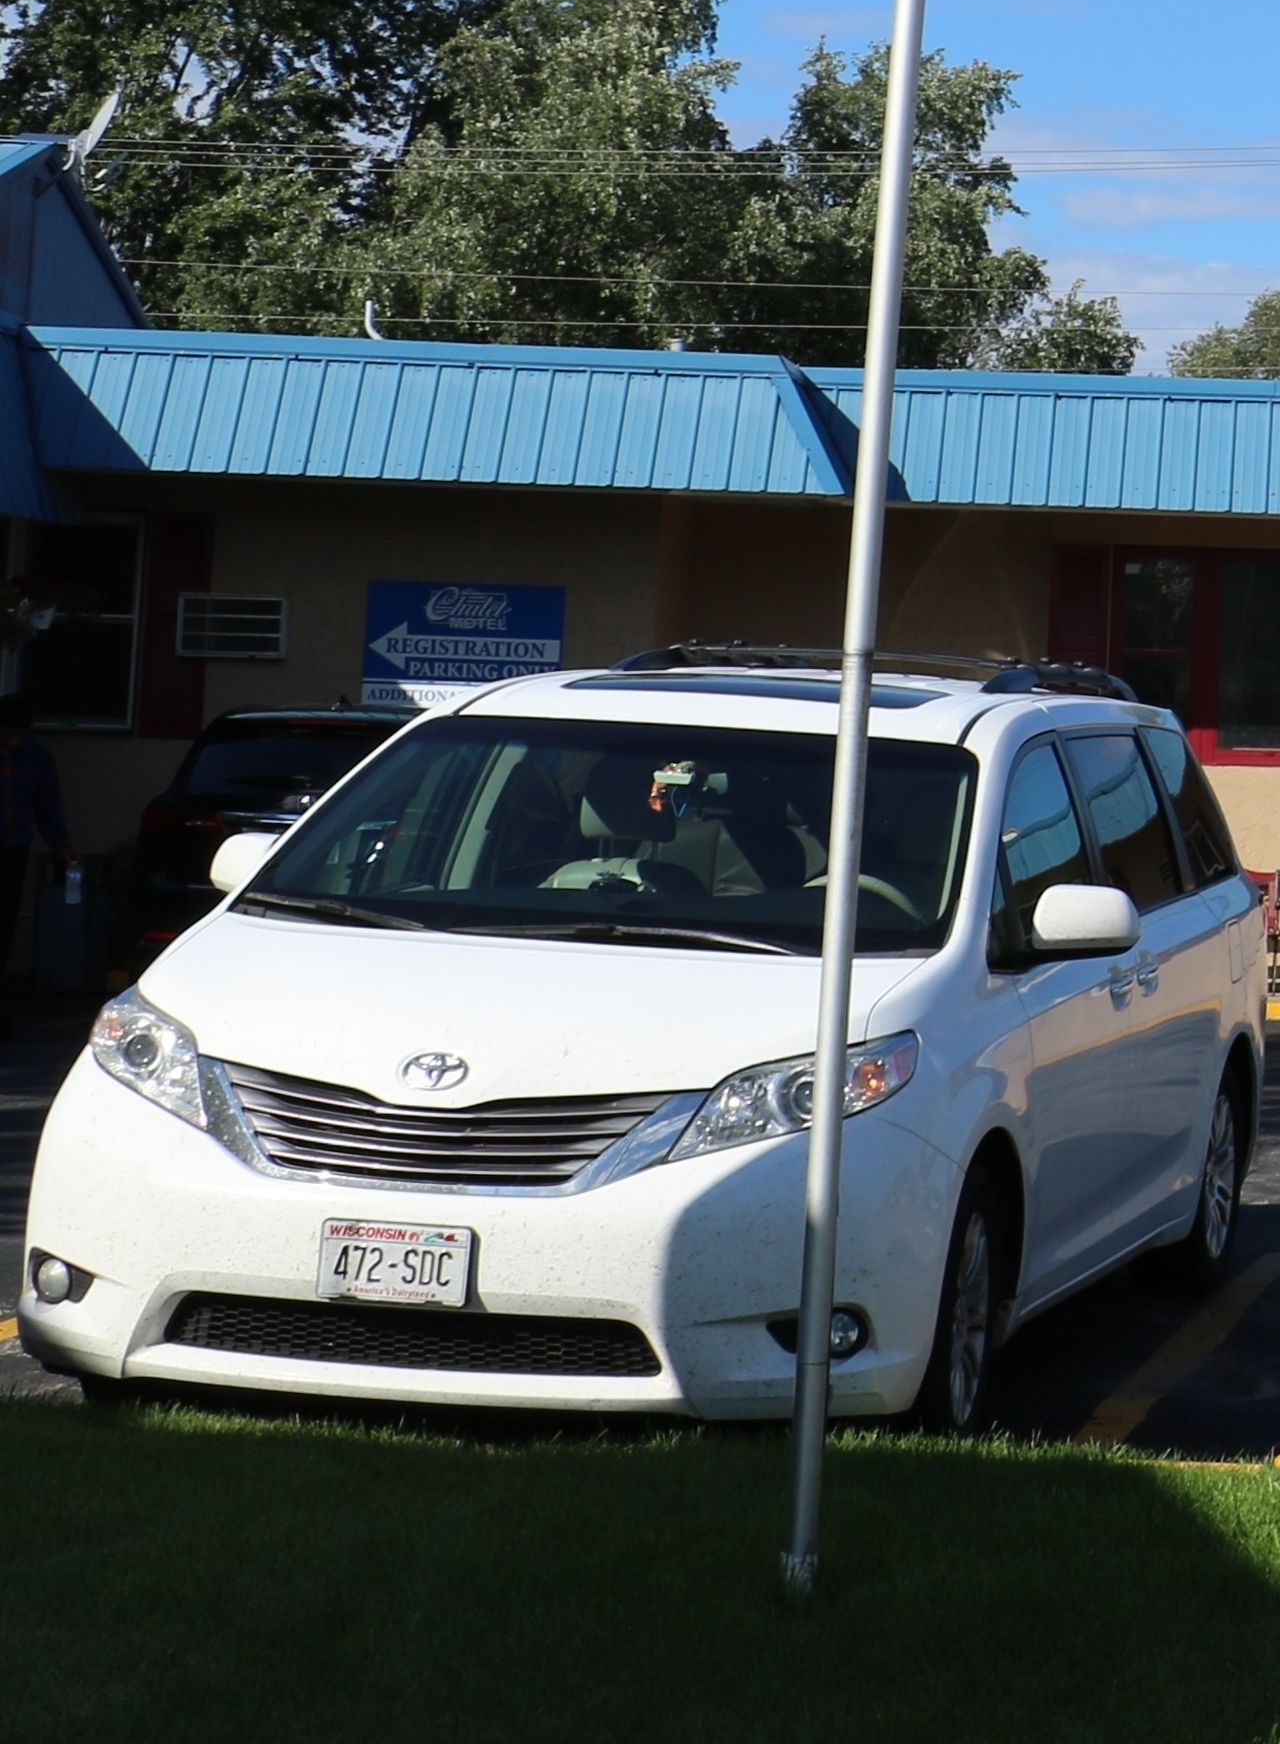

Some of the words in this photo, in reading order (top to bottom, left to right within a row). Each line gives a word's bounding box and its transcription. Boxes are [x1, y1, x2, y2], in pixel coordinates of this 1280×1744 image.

[449, 617, 508, 631] MOTEL
[386, 637, 546, 658] REGISTRATION
[408, 661, 499, 680] PARKING
[330, 1225, 407, 1241] WISCONSIN
[333, 1244, 453, 1287] 472-SDC
